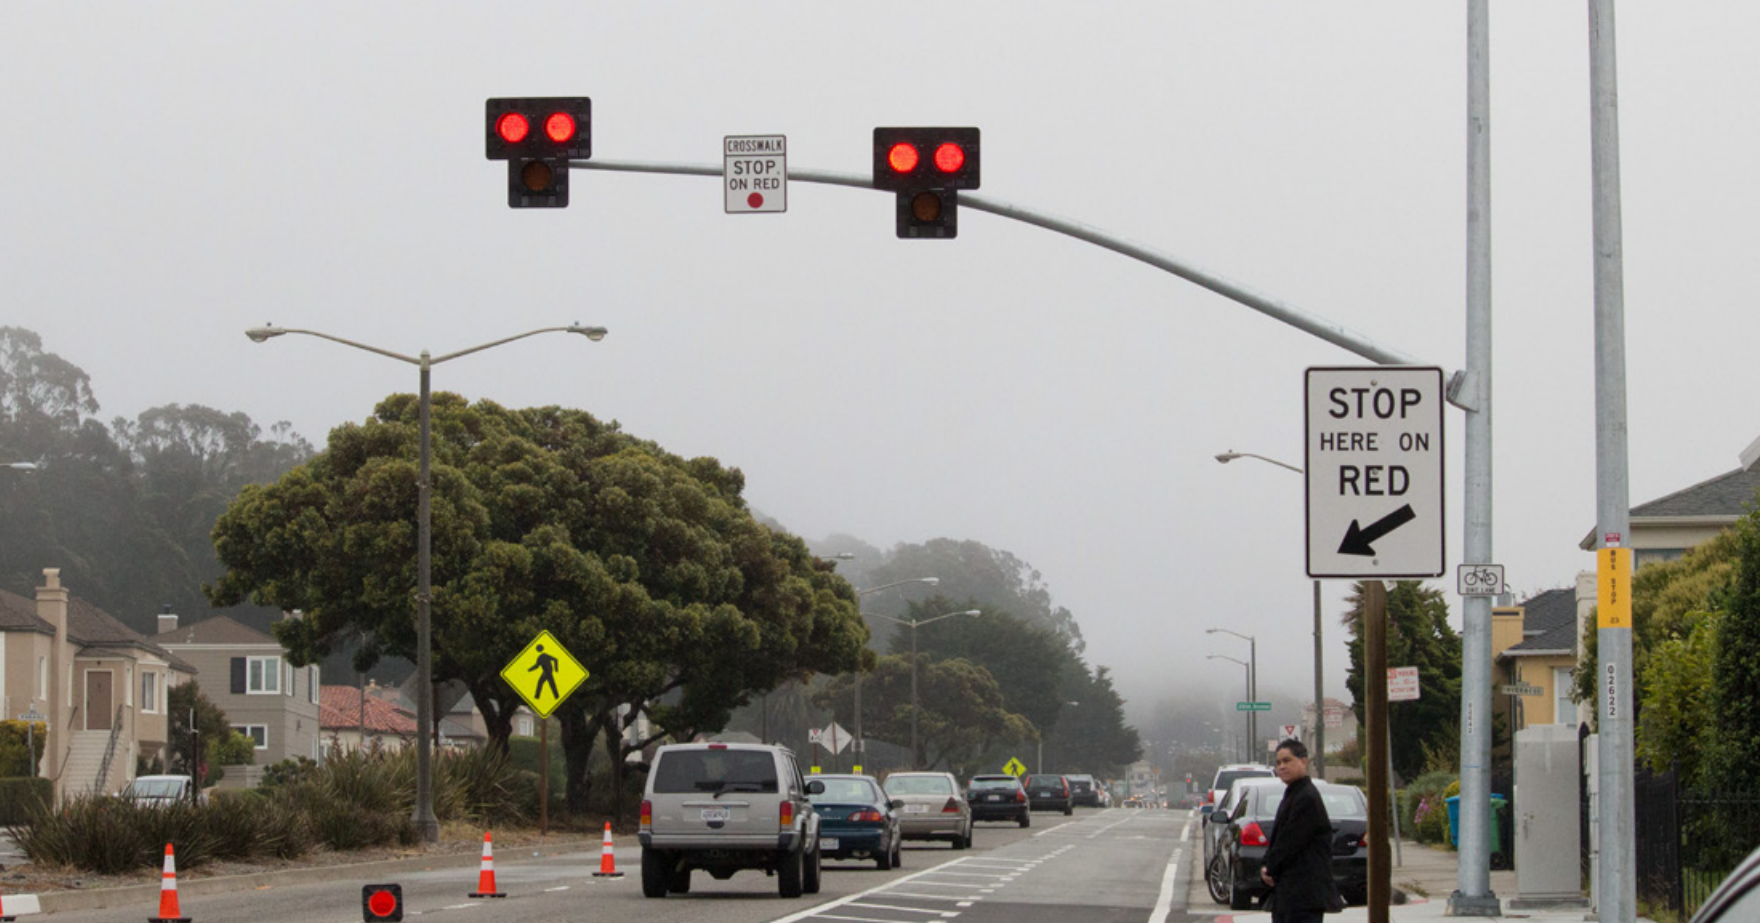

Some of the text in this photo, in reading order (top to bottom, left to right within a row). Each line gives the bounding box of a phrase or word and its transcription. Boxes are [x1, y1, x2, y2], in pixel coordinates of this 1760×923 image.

[728, 139, 782, 152] CROSSWALK
[734, 160, 776, 175] STOP
[729, 178, 780, 190] ON RED
[1328, 387, 1422, 419] STOP
[1320, 432, 1429, 451] HERE ON
[1339, 465, 1410, 496] RED
[1607, 665, 1616, 716] 02622
